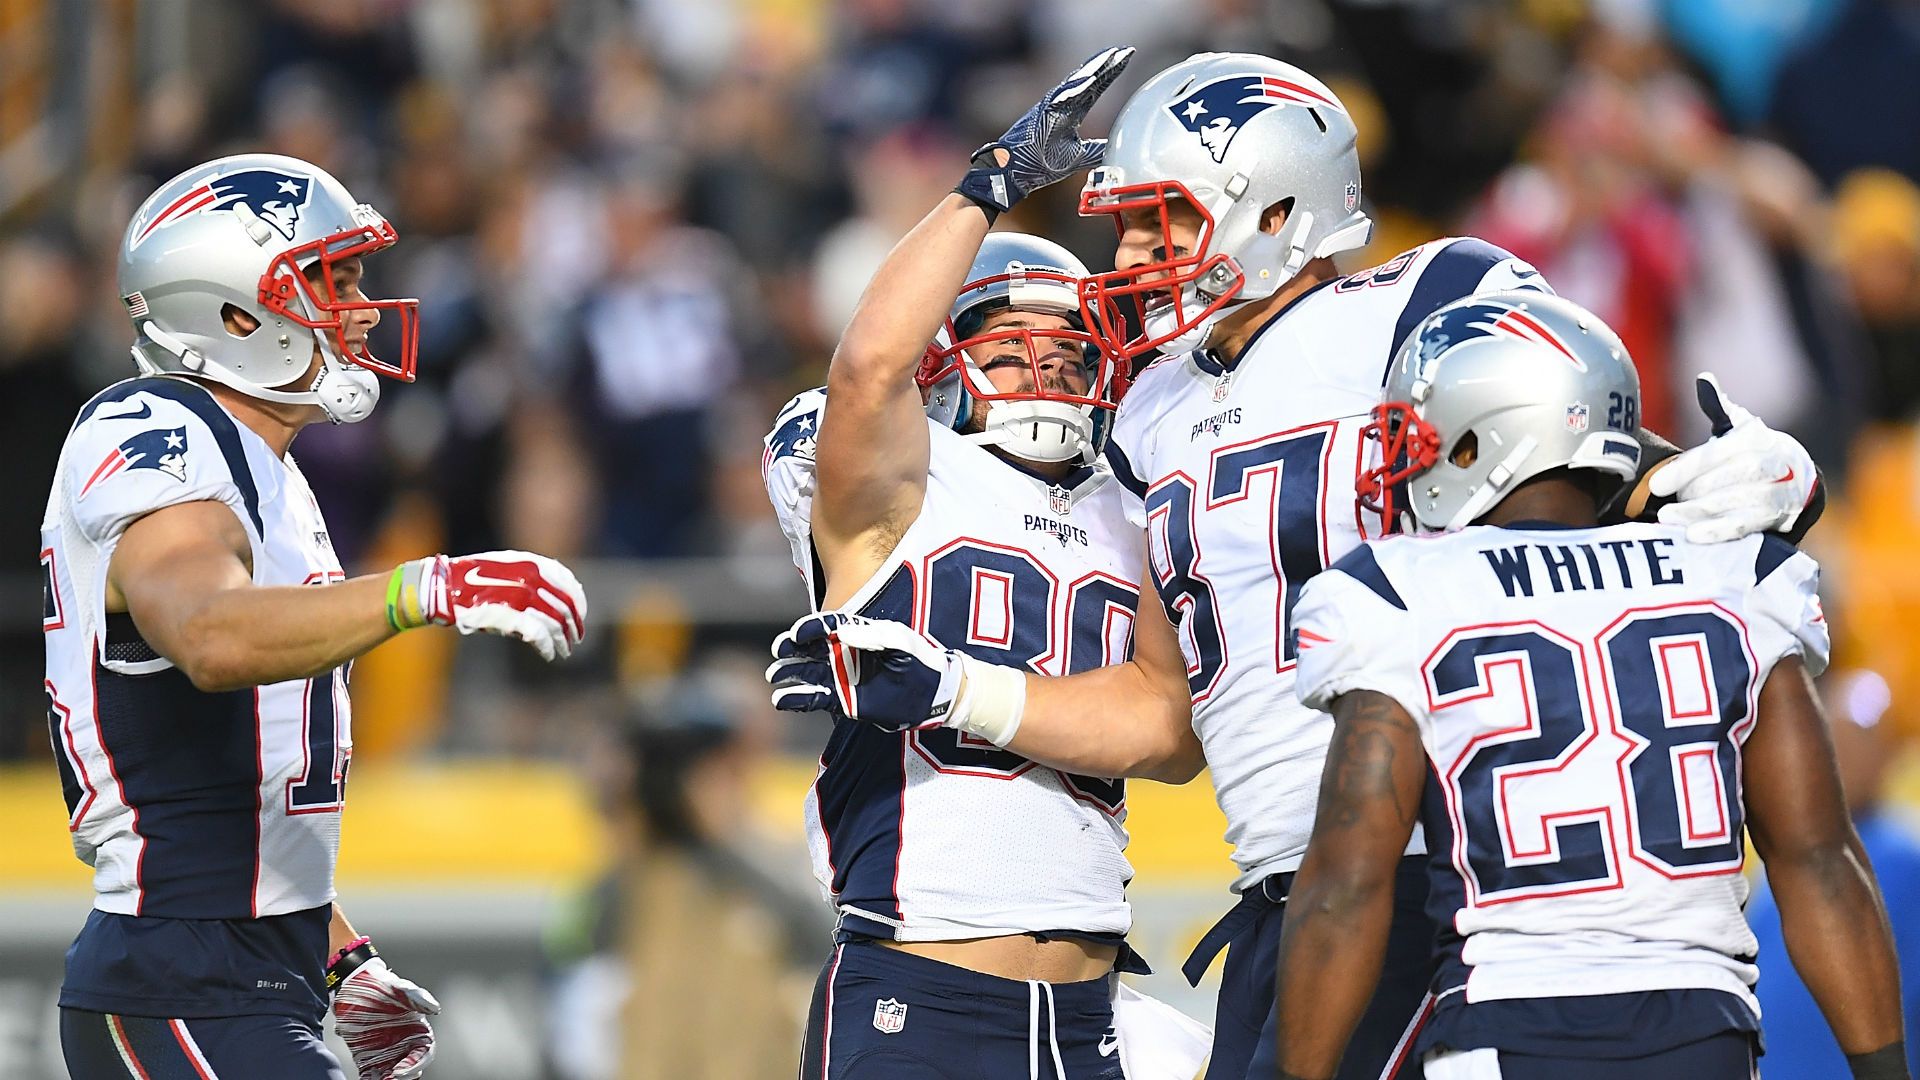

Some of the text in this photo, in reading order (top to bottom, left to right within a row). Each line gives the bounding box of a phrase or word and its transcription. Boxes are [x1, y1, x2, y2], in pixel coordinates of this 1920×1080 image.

[1191, 407, 1242, 443] PATRIOTS
[1608, 391, 1635, 433] 28
[1023, 514, 1088, 547] PATRIOTS
[1145, 420, 1339, 706] 87
[1478, 538, 1684, 597] WHITE
[1420, 600, 1758, 908] 28
[256, 979, 288, 990] DRI-FIT
